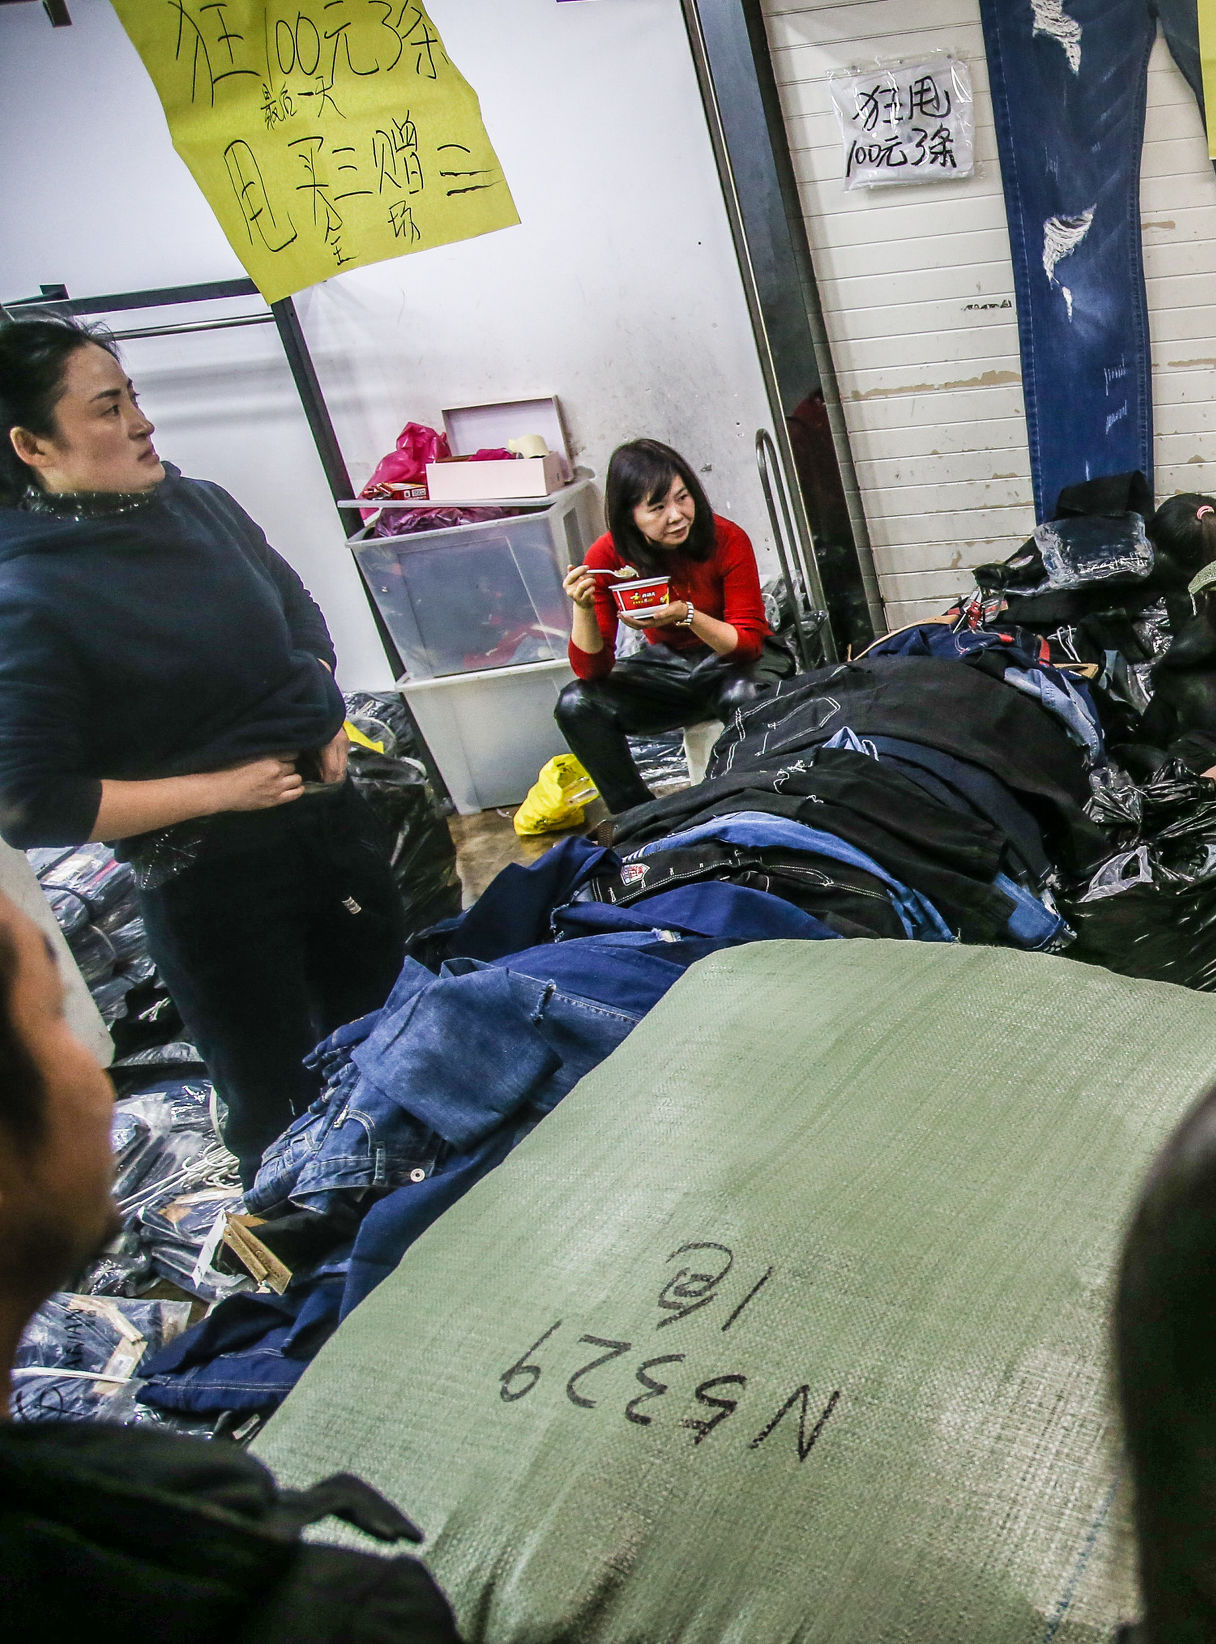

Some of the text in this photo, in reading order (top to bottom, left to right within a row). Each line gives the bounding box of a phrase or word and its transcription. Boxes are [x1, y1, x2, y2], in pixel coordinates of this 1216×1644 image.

[852, 75, 952, 132] 狂甩
[846, 122, 957, 178] 100元3条
[499, 1319, 841, 1463] N5329
